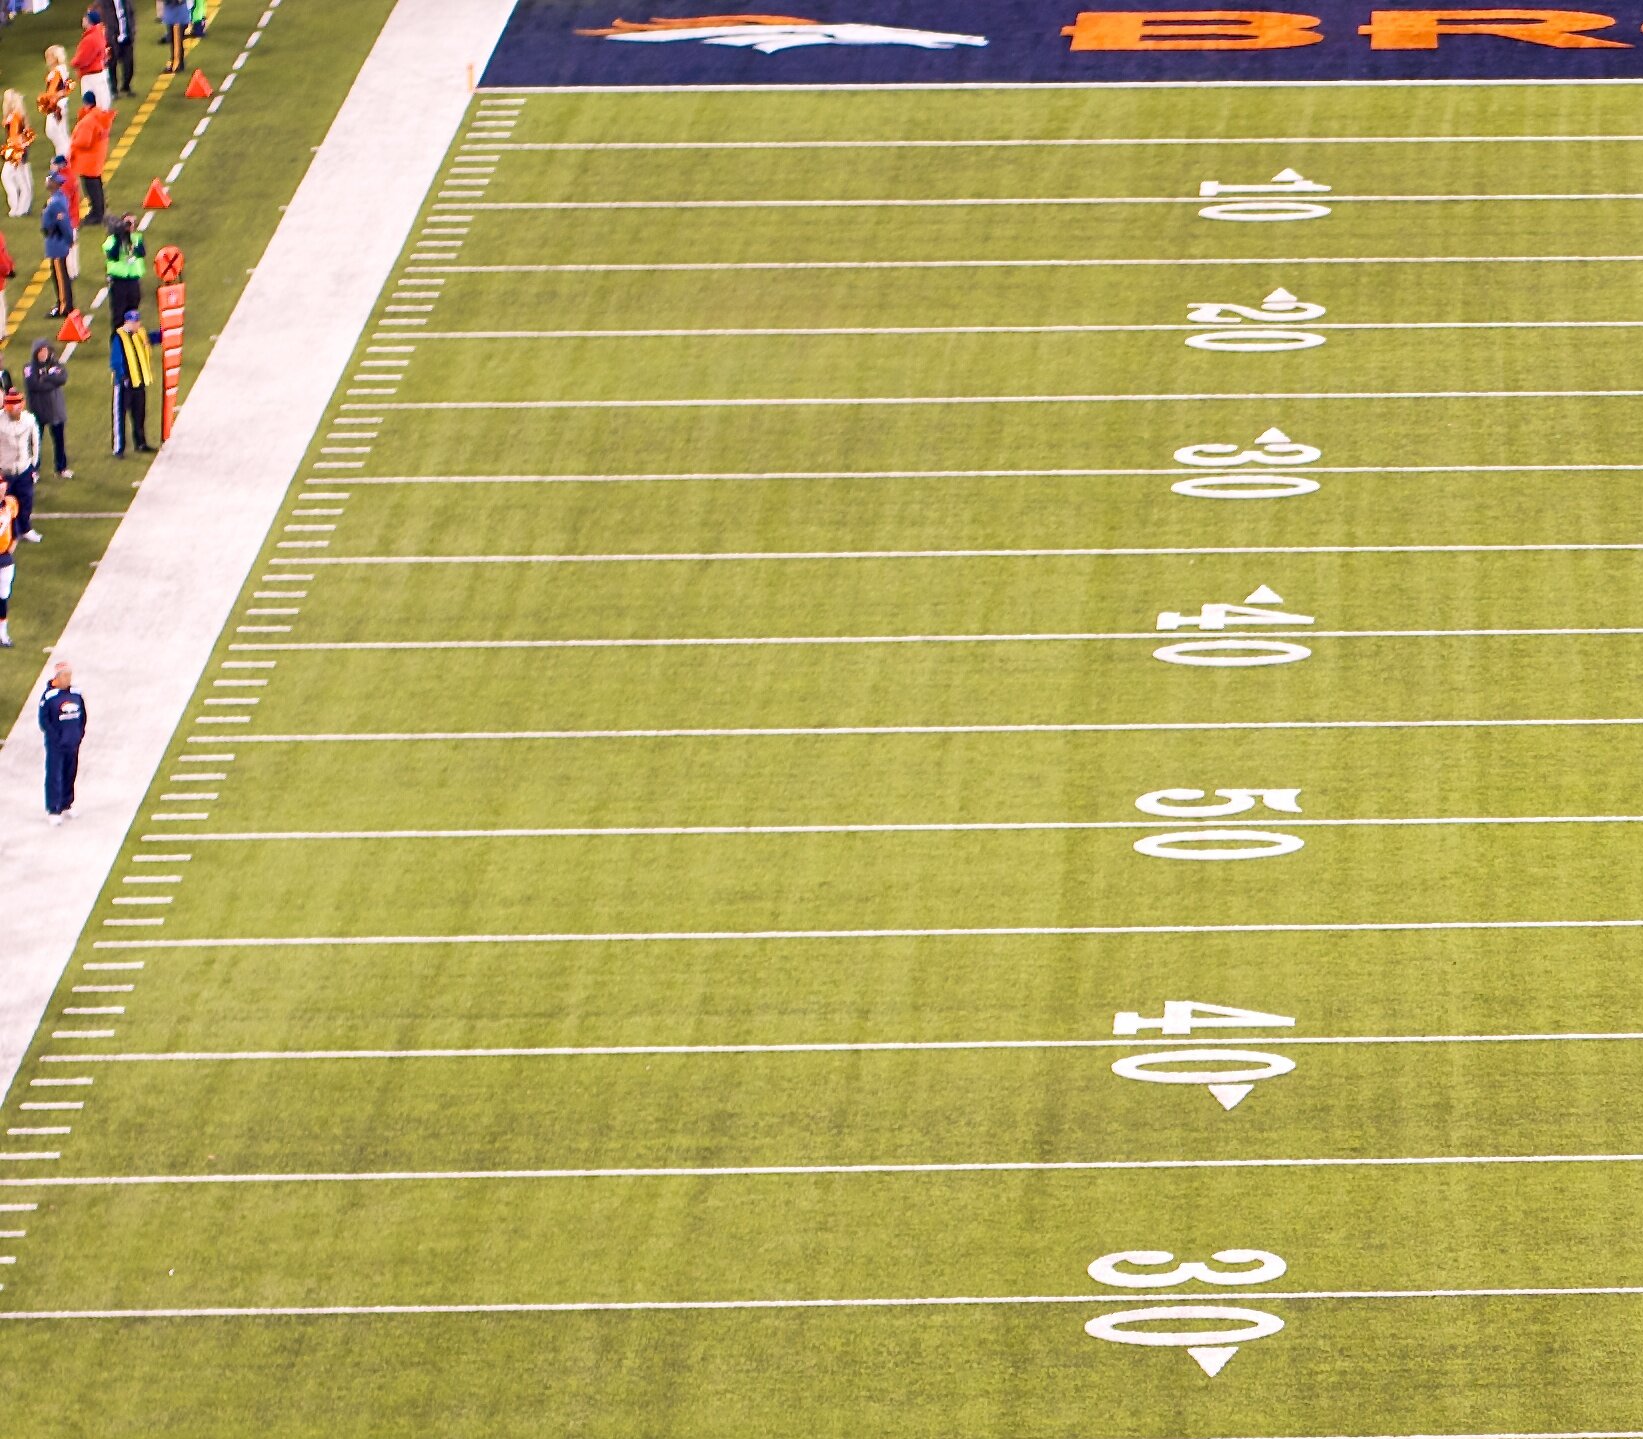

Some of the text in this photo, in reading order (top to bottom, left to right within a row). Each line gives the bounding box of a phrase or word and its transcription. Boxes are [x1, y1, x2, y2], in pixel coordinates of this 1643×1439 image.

[1198, 180, 1333, 222] 10
[1184, 302, 1327, 352] 20
[1170, 443, 1322, 499] 30
[1152, 603, 1315, 666] 40
[1133, 788, 1305, 860] 50
[1110, 1001, 1296, 1084] 40
[1084, 1248, 1287, 1347] 30
